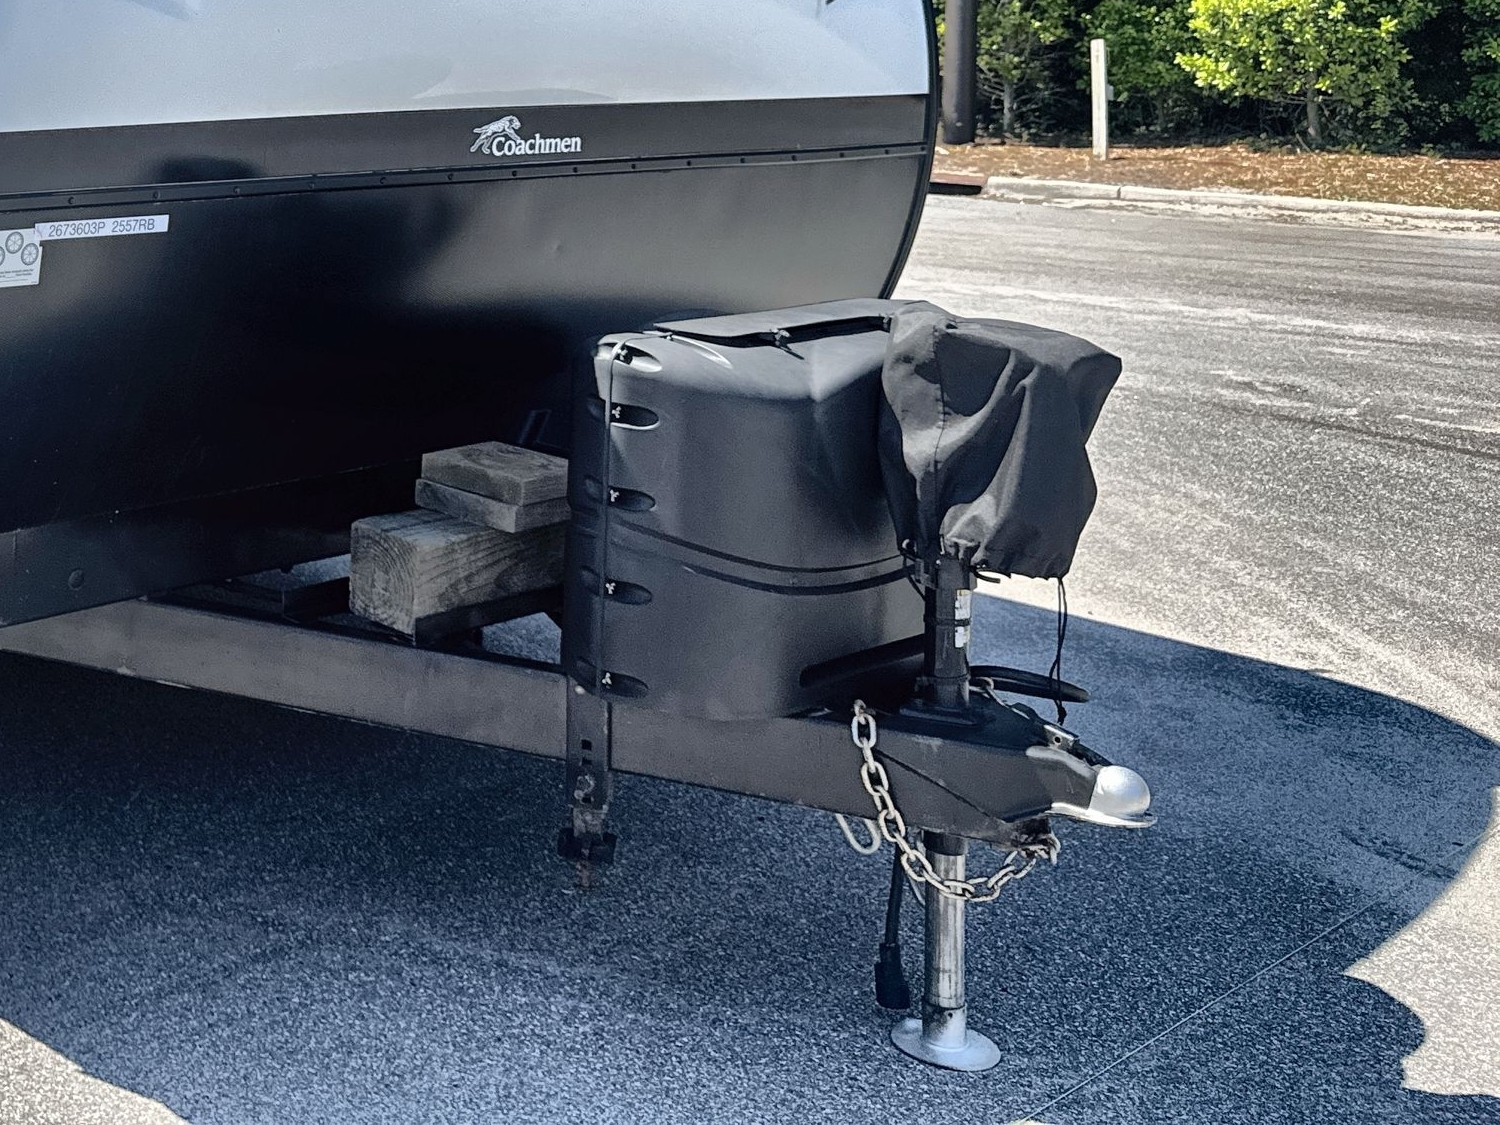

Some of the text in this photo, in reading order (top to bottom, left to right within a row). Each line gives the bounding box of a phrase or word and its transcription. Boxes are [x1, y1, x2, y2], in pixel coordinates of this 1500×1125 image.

[491, 133, 582, 157] Coachmen
[48, 218, 155, 237] 2673603P 2557RB
